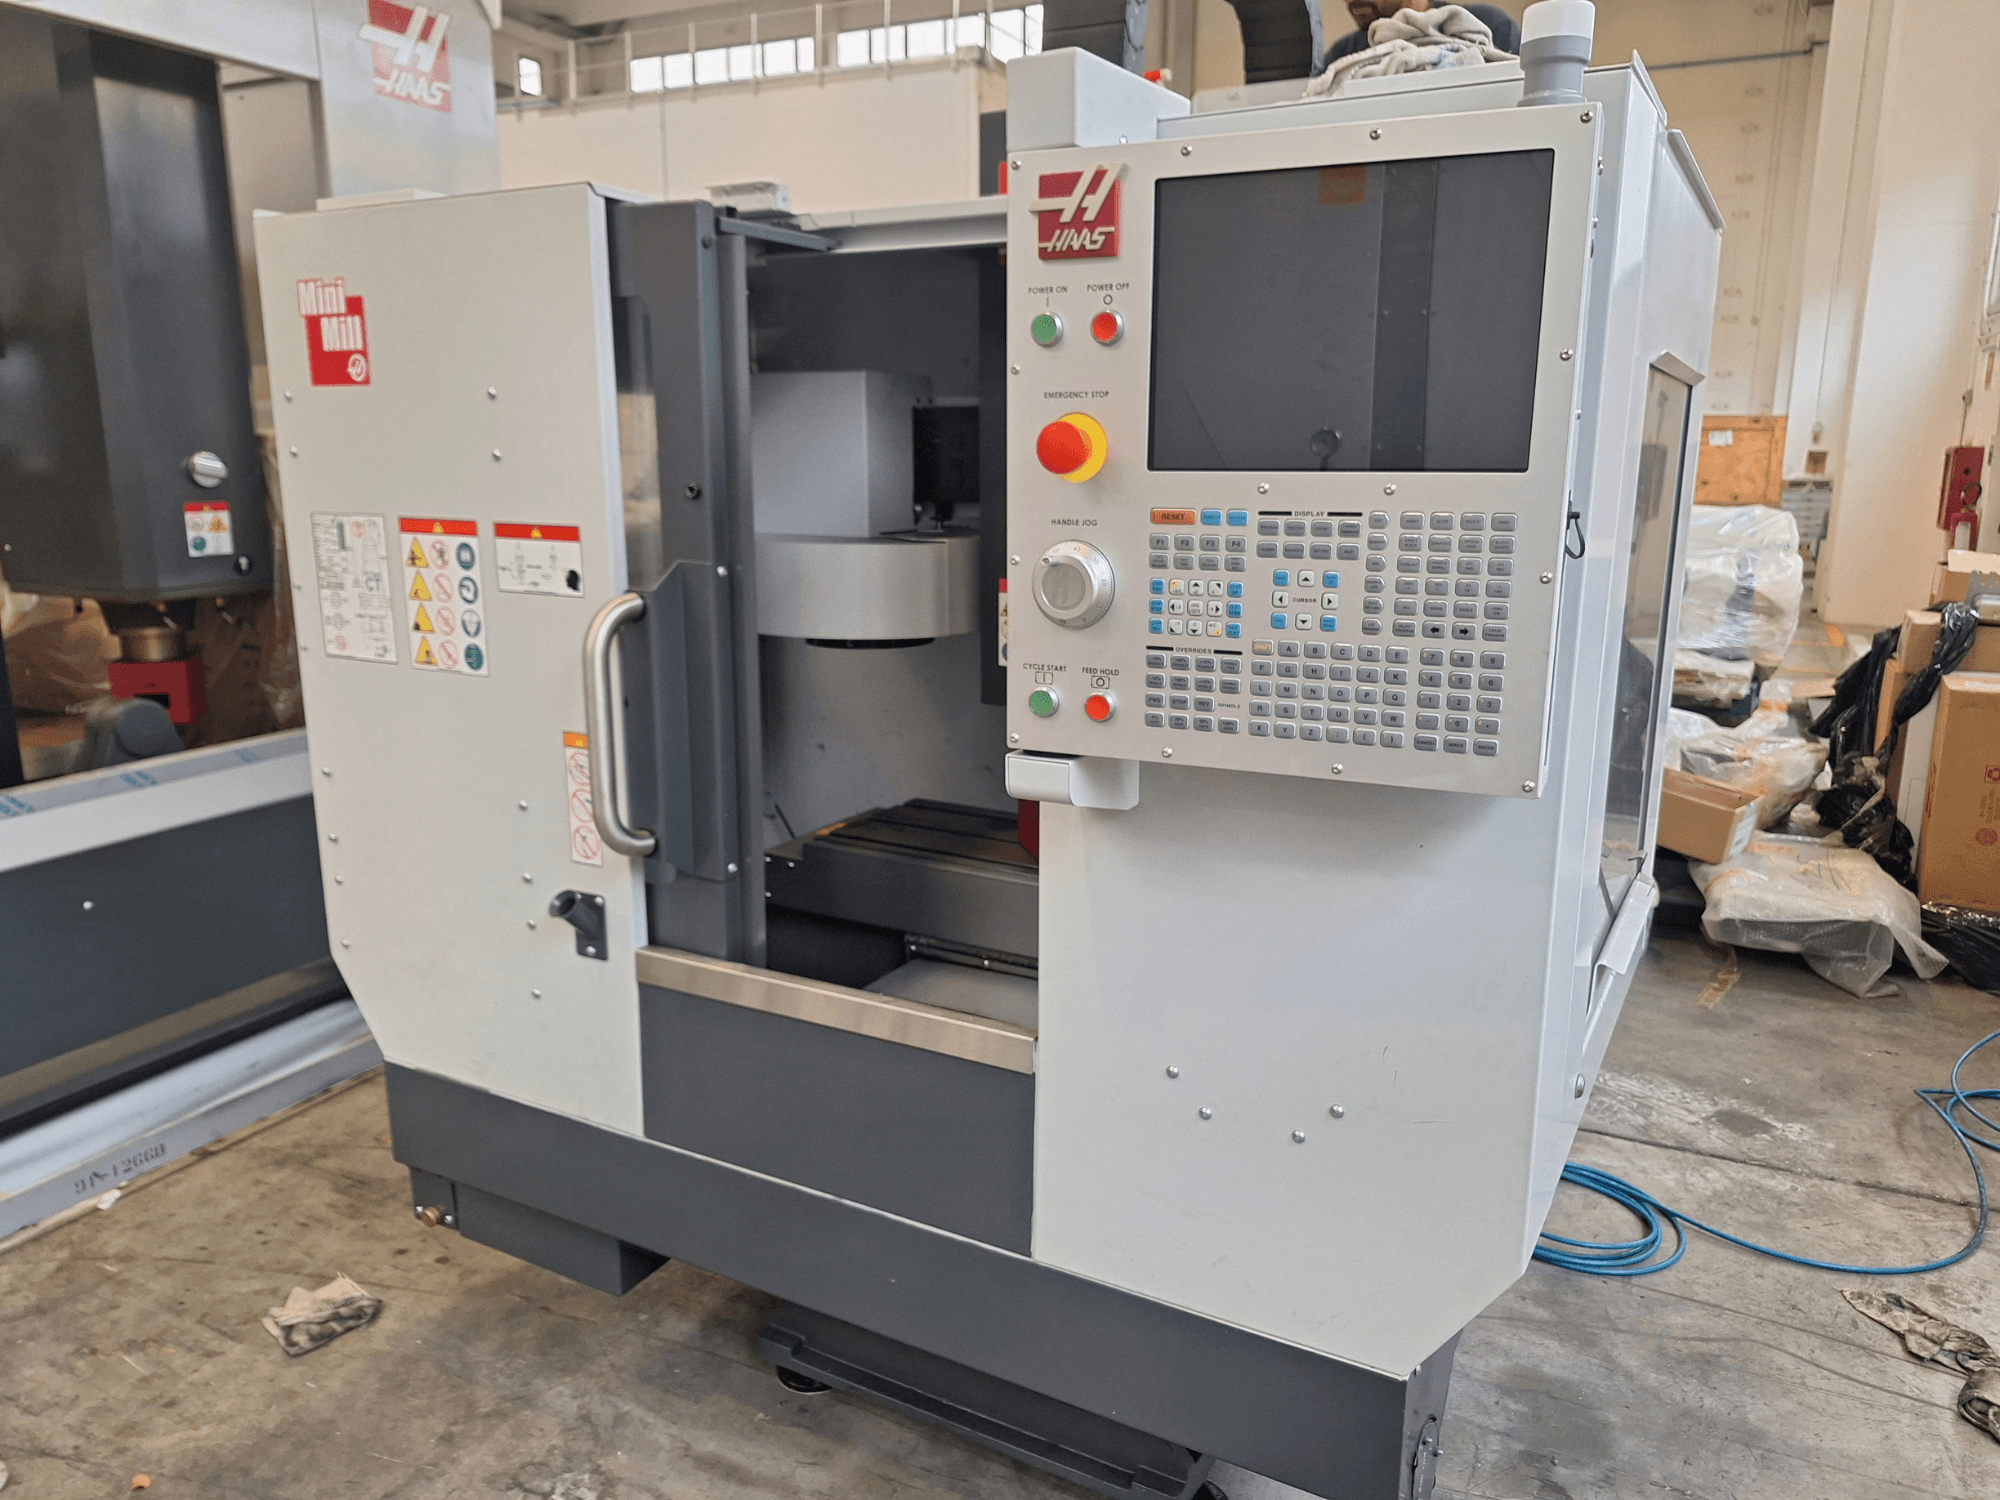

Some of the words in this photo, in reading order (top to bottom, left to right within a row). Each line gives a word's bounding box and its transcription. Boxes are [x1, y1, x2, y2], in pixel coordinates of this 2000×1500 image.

[372, 69, 450, 106] HAAS
[1038, 226, 1115, 252] HAAS
[1087, 283, 1113, 292] POWER
[1115, 282, 1130, 291] OFF
[297, 278, 345, 315] Mini
[321, 315, 363, 351] Mill
[1044, 391, 1088, 399] EMERGENCY
[1023, 663, 1045, 671] CYCLE
[1047, 664, 1066, 672] START
[1100, 668, 1119, 676] HOLD
